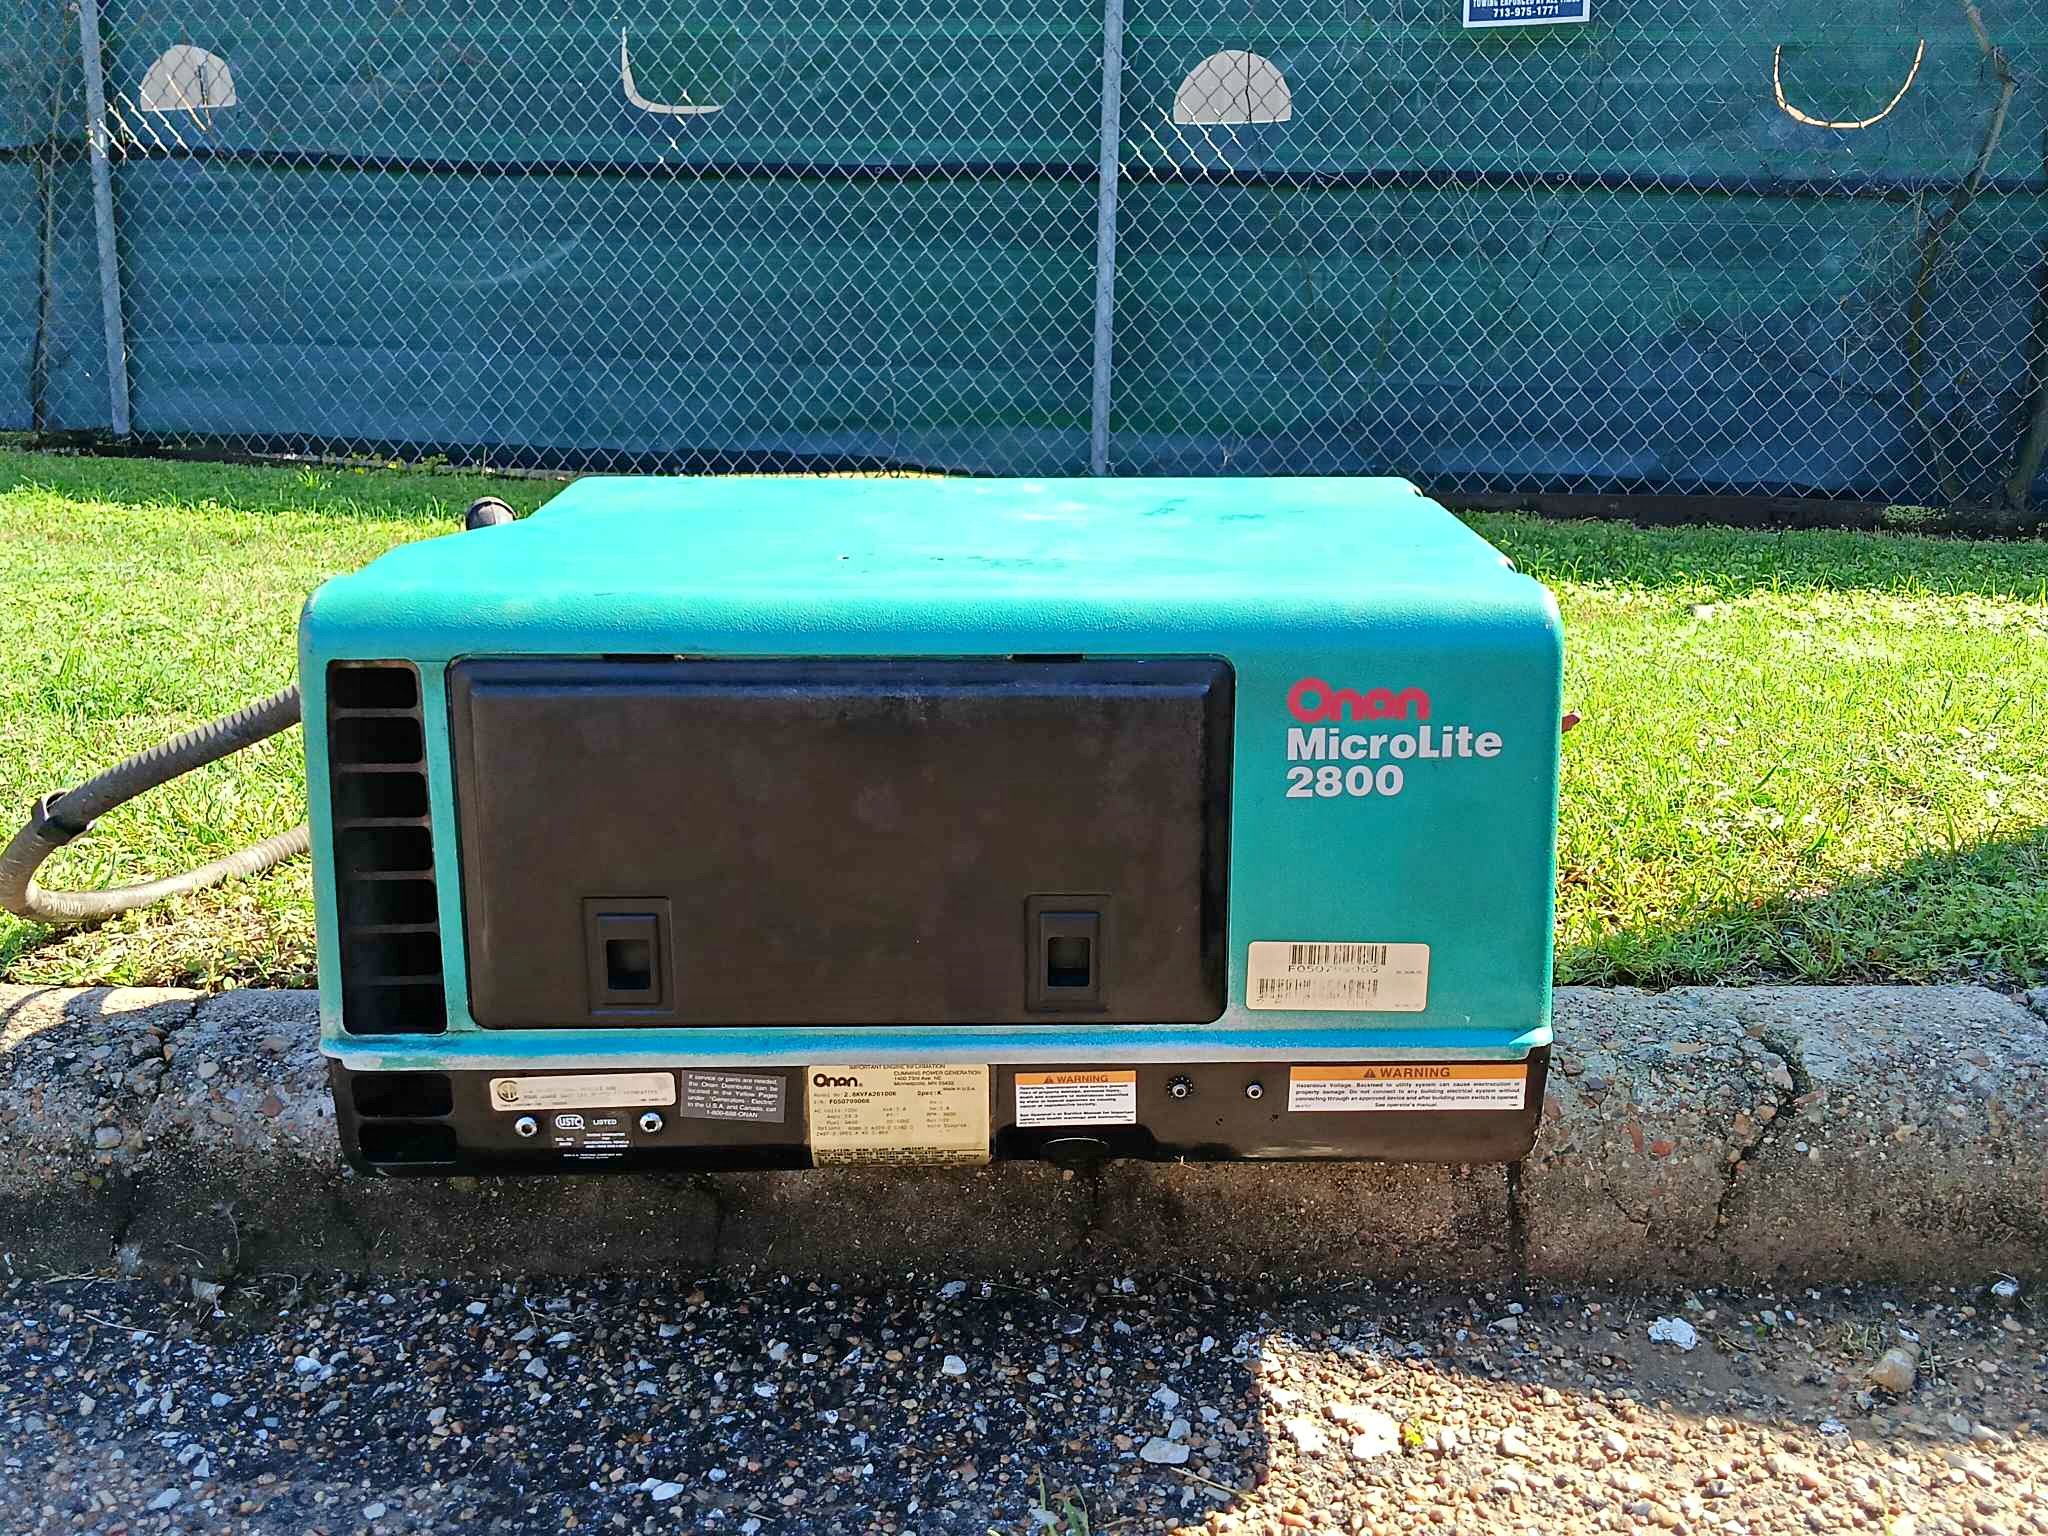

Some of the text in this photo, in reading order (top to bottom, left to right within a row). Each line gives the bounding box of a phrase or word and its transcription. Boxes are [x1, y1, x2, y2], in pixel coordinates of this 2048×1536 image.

[1493, 5, 1559, 18] 713-975-1771
[1287, 677, 1431, 723] Onan
[1287, 725, 1503, 761] MicroLite
[1286, 764, 1405, 798] 2800
[1056, 1074, 1109, 1084] WARNING
[1380, 1067, 1451, 1078] WARNING
[813, 1073, 858, 1087] Onan
